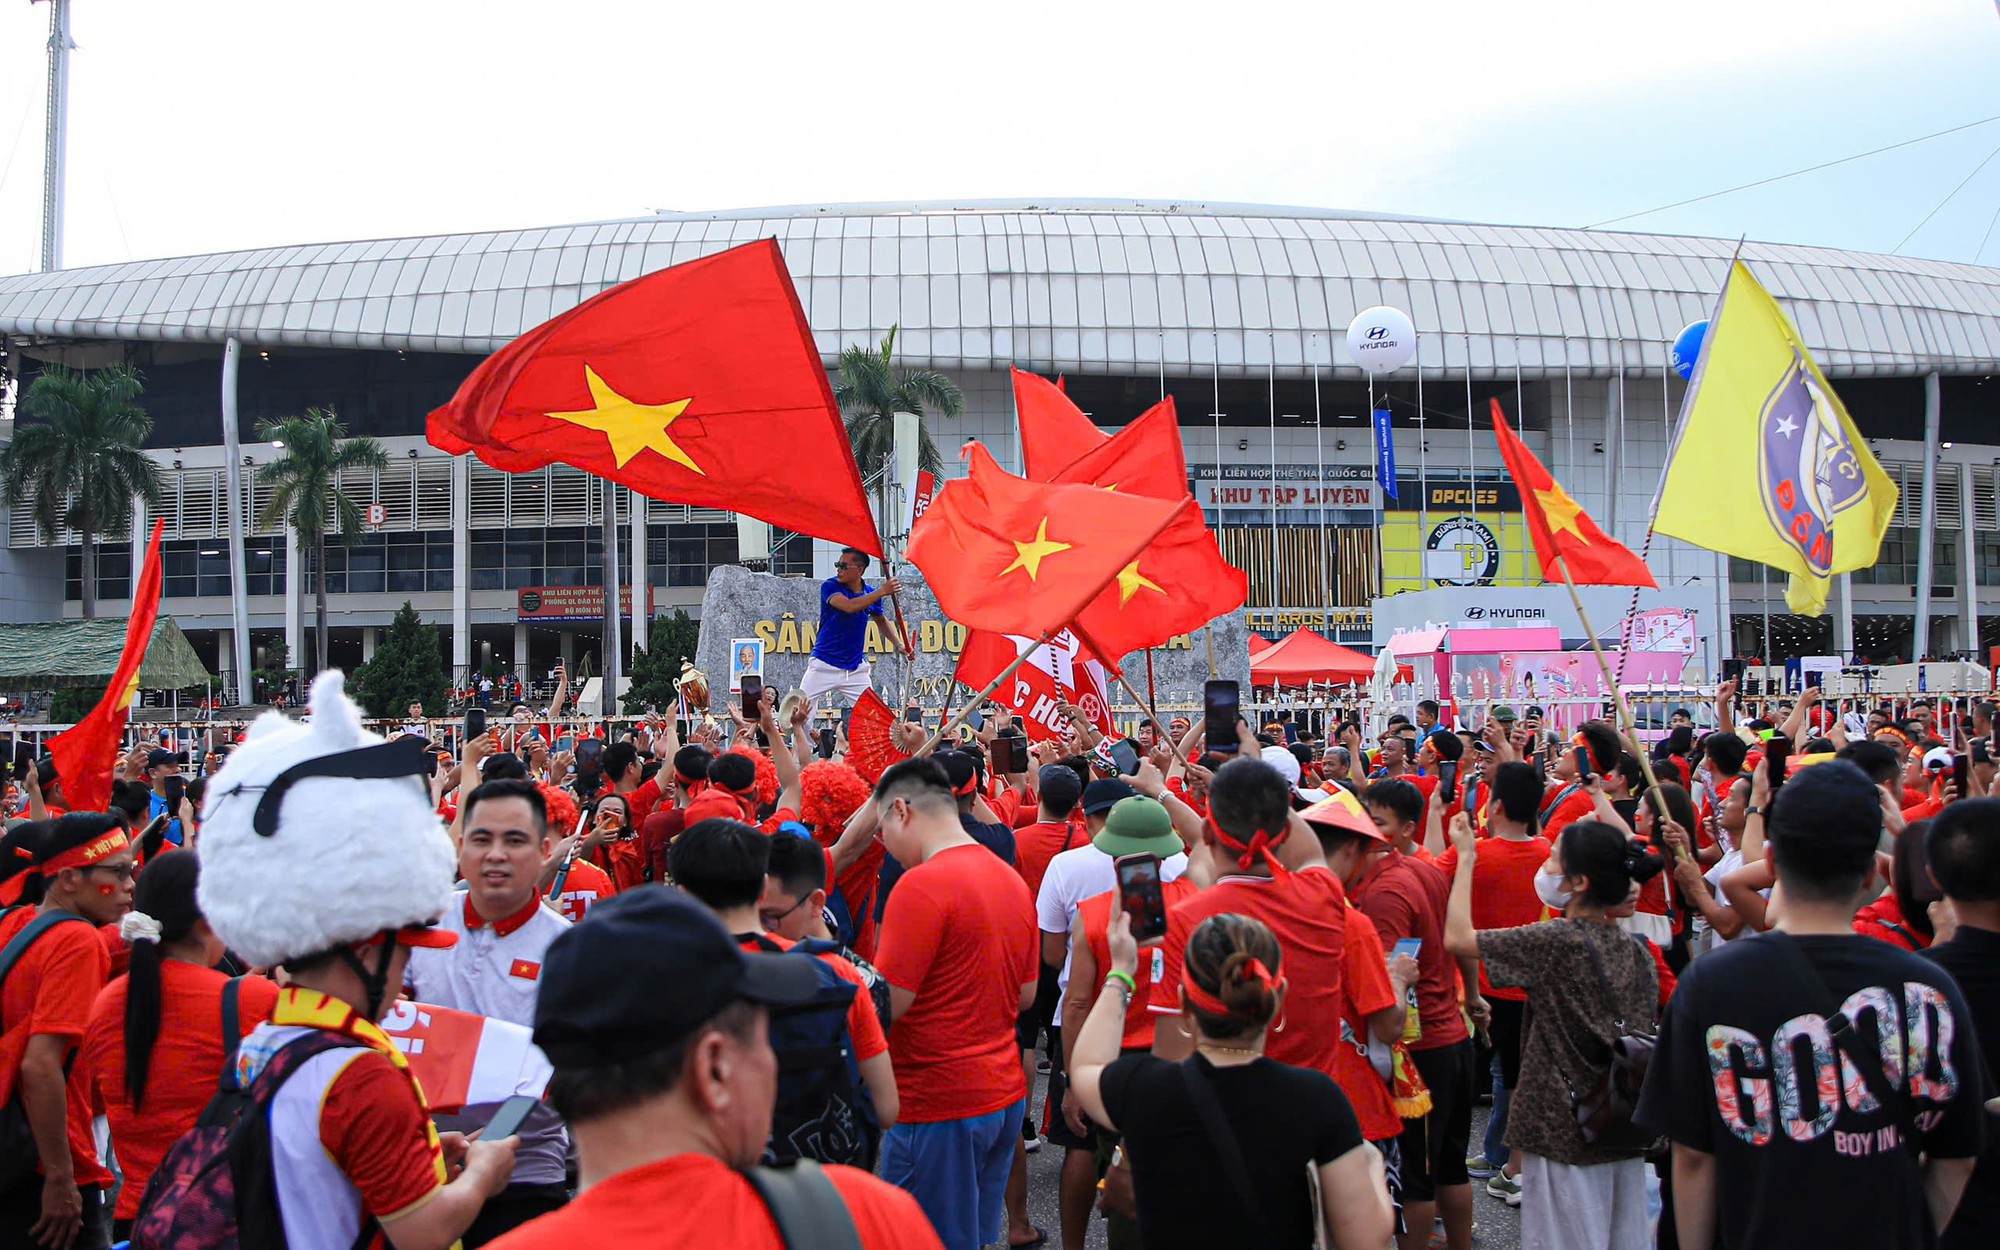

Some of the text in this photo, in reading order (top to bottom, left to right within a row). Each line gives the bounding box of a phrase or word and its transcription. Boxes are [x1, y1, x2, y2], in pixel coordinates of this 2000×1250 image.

[1359, 341, 1398, 351] HYUNDAI
[1200, 465, 1378, 479] KHU LIÊN HỢP THỂ THAO QUỐC GIA
[1211, 487, 1252, 504] KHU
[1258, 484, 1298, 507] TẬP
[1304, 484, 1370, 507] LUYỆN
[371, 505, 384, 524] B
[557, 588, 572, 597] LIÊN
[575, 606, 591, 614] MÔN
[1489, 608, 1545, 618] HYUNDAI
[754, 612, 818, 654] SÂN
[1834, 1124, 1898, 1157] BOY IN
